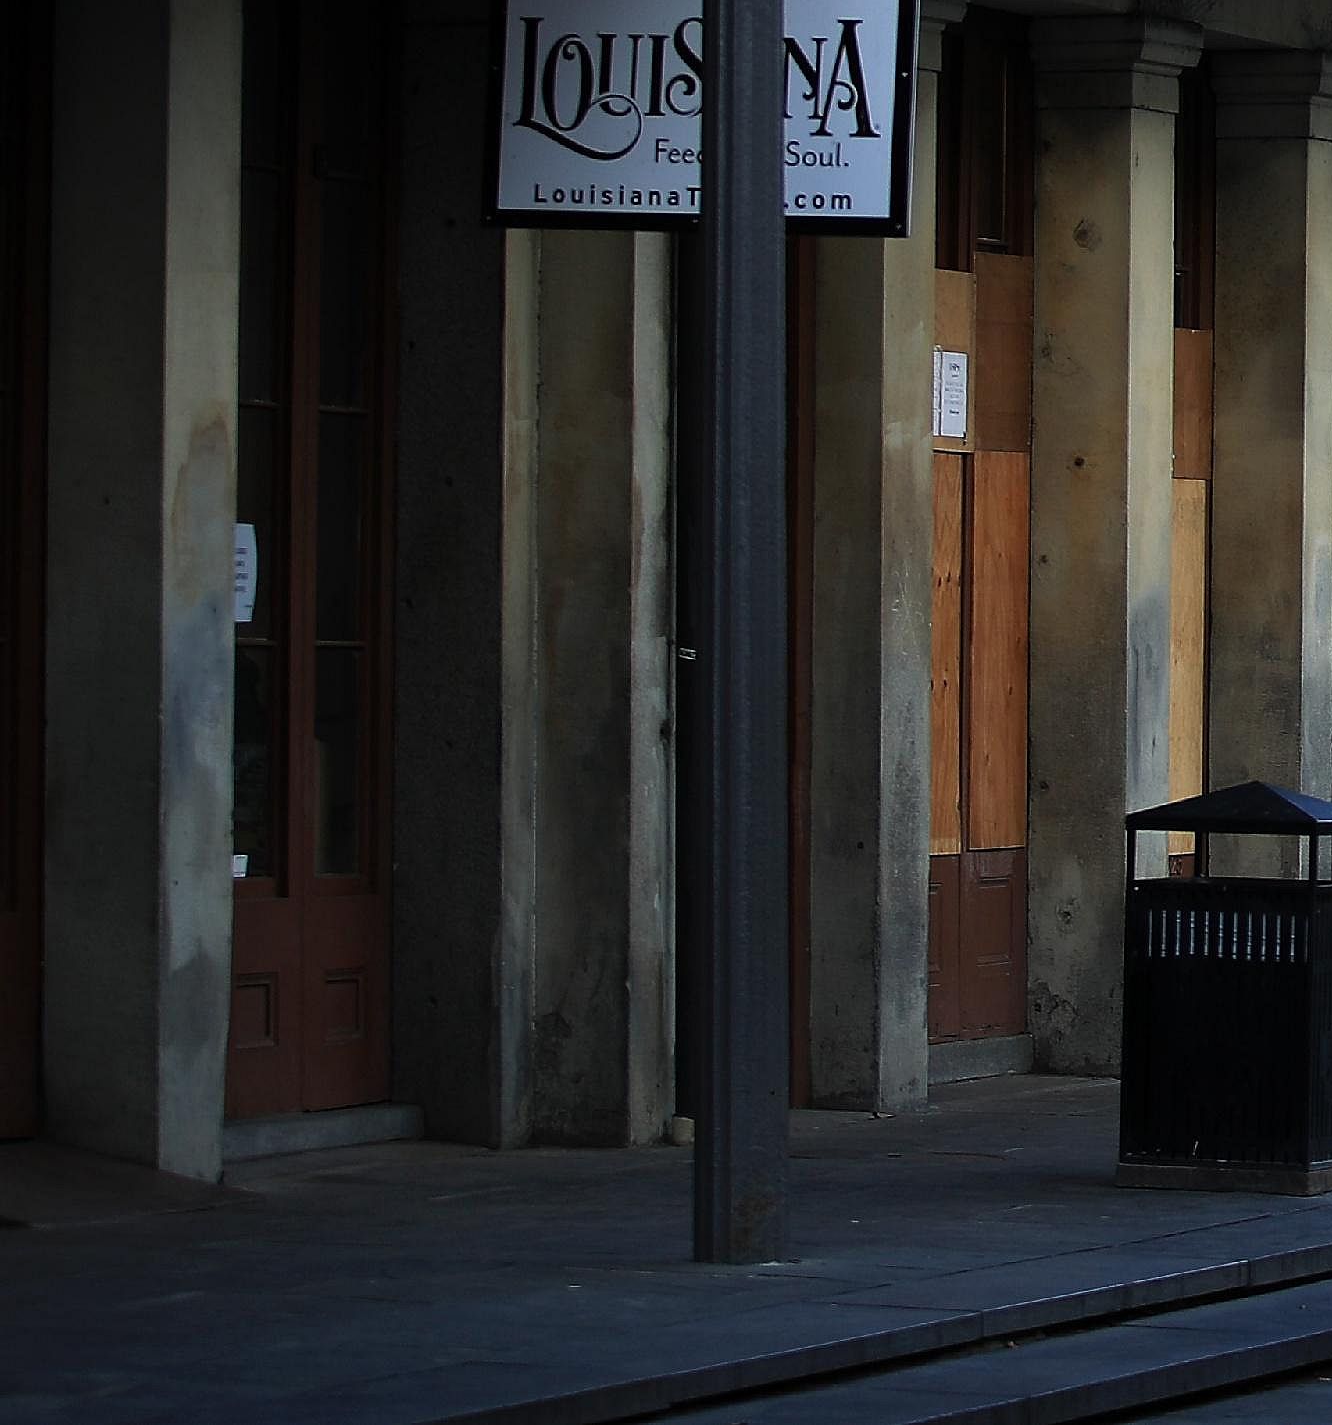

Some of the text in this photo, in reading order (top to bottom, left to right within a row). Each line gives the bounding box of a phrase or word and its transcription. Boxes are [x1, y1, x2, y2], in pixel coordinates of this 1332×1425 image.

[513, 16, 881, 160] LOUISNA
[785, 141, 850, 168] Soul.
[534, 183, 853, 210] LouisianaT.com
